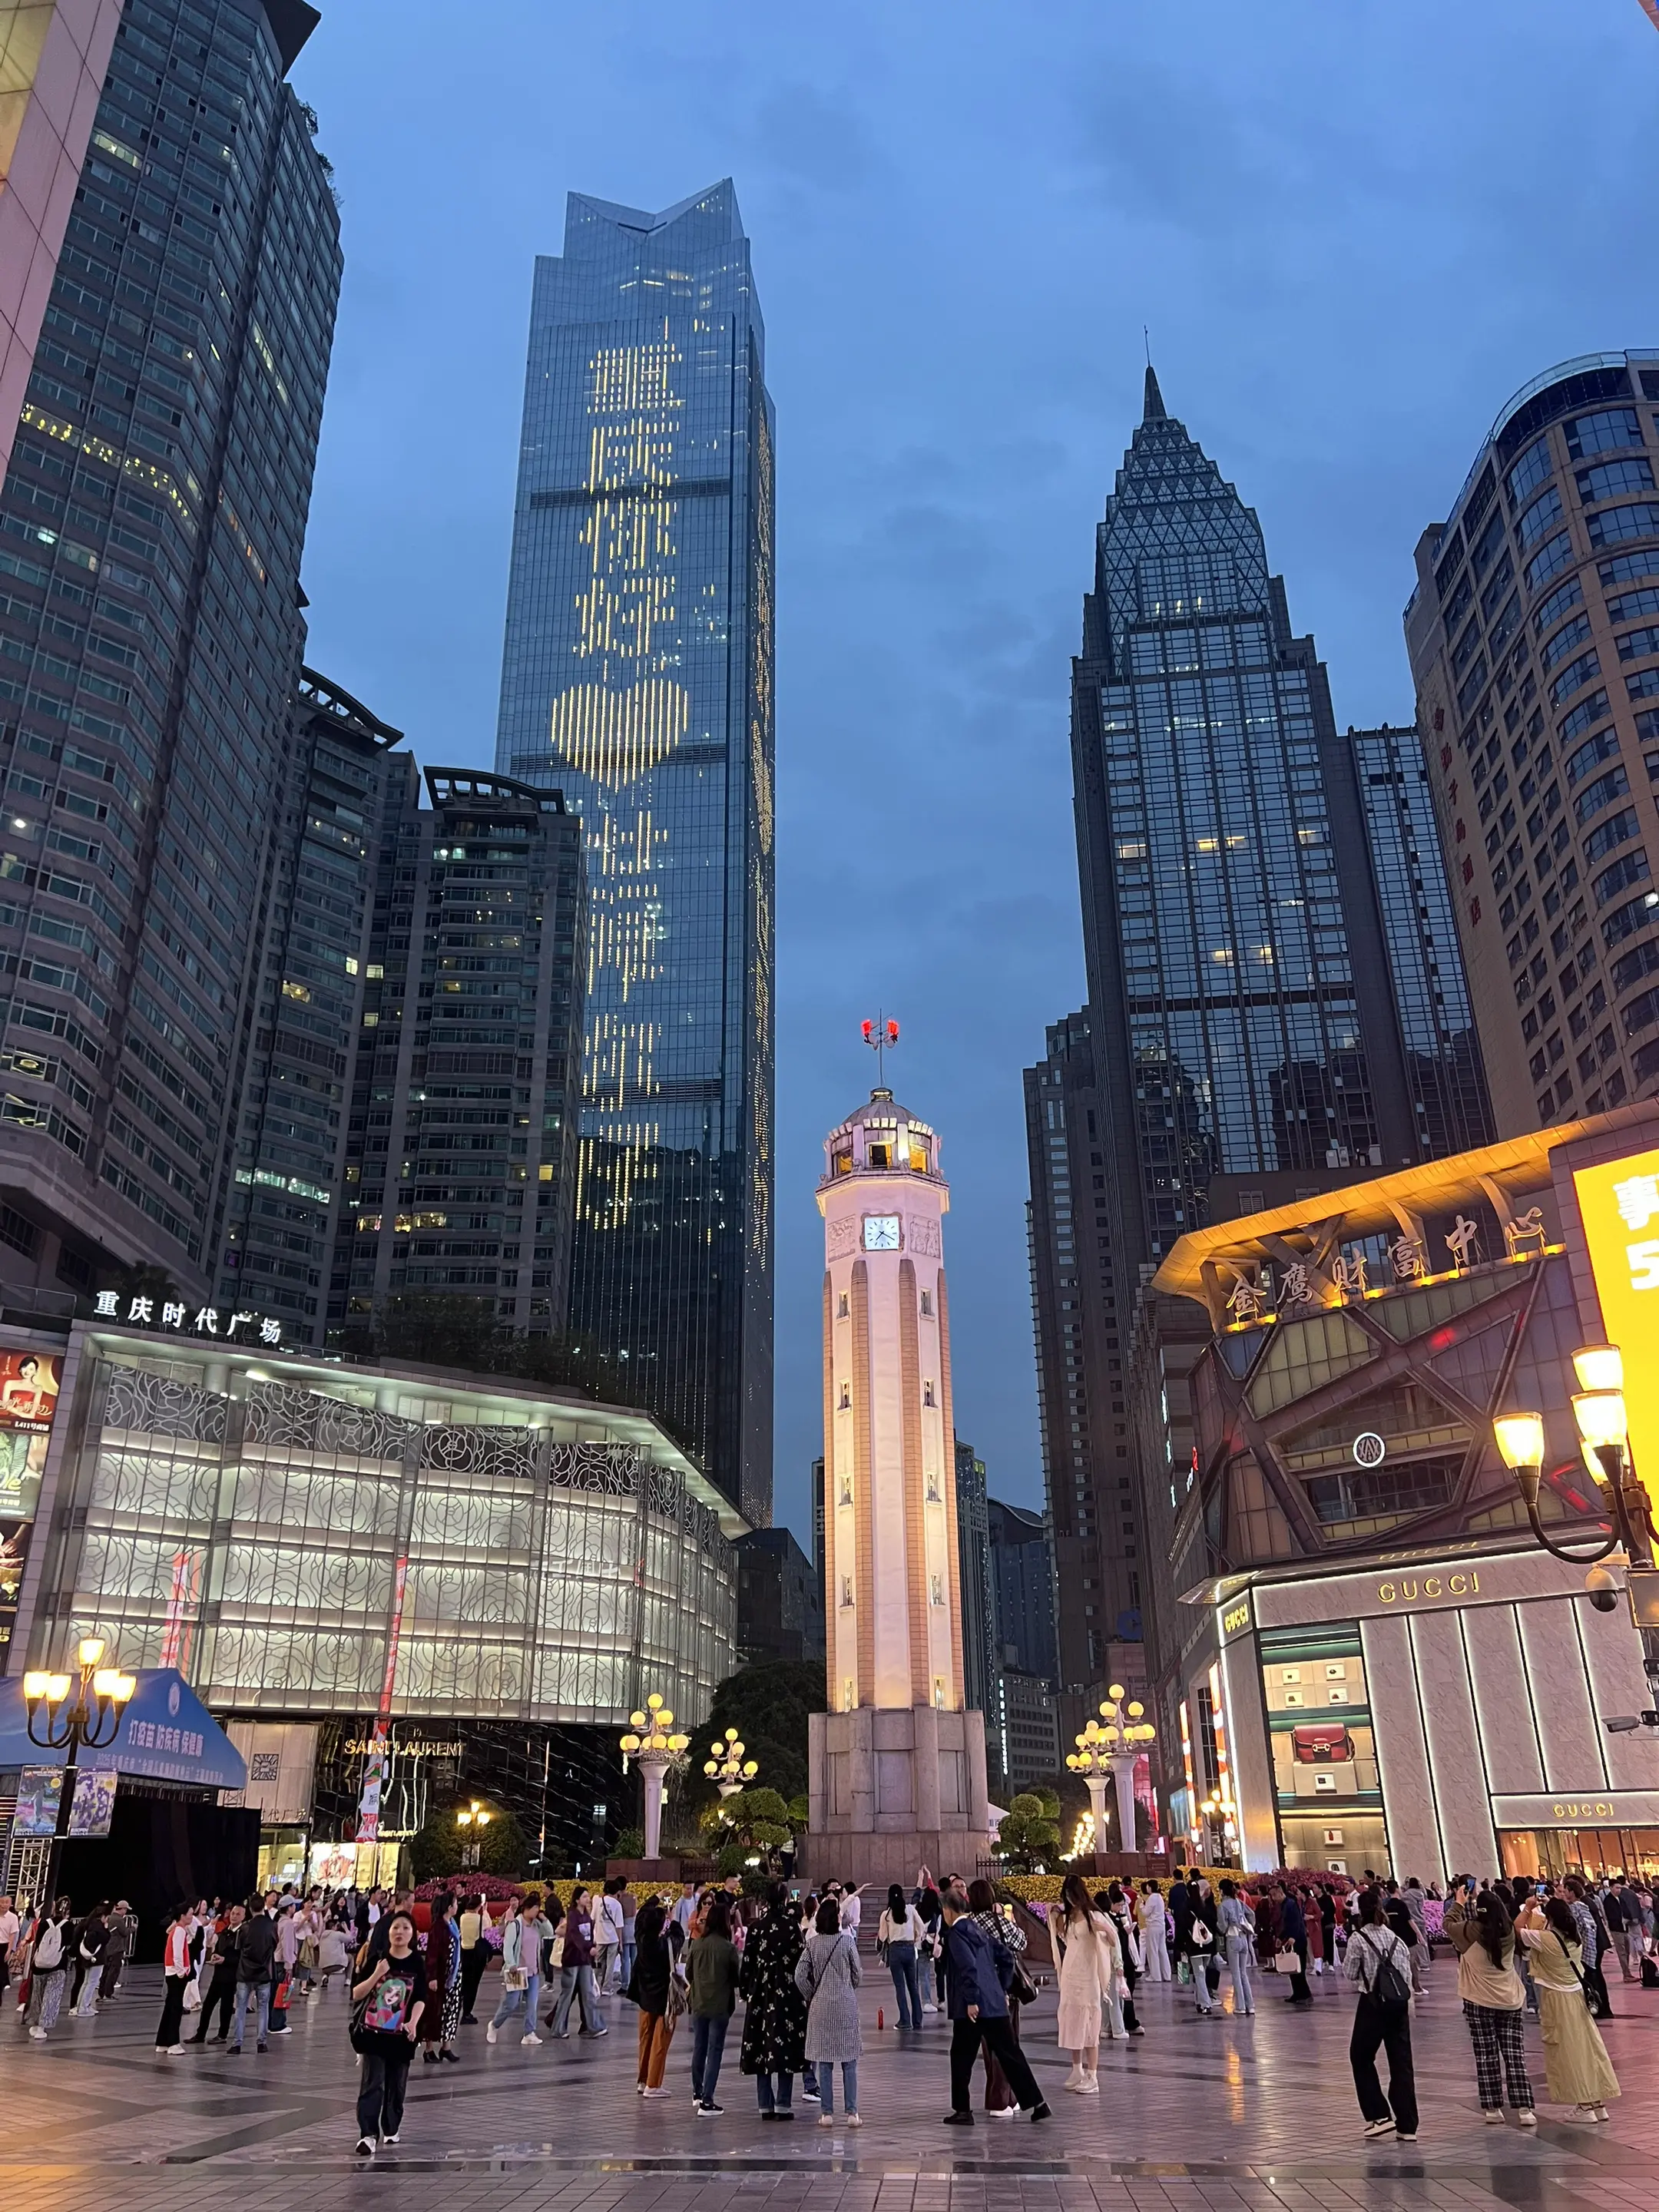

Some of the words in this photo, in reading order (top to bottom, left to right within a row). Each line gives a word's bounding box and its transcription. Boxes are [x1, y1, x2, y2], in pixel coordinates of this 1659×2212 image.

[1613, 1173, 1659, 1230] 事
[1227, 1207, 1542, 1310] 金鹰财富中心
[94, 1291, 282, 1343] 重庆时代广场
[1378, 1572, 1479, 1602] GUCCI
[1224, 1604, 1248, 1633] GUCCI
[345, 1739, 392, 1755] SAINT
[394, 1740, 467, 1757] LAURENT
[1552, 1803, 1614, 1817] GUCCI
